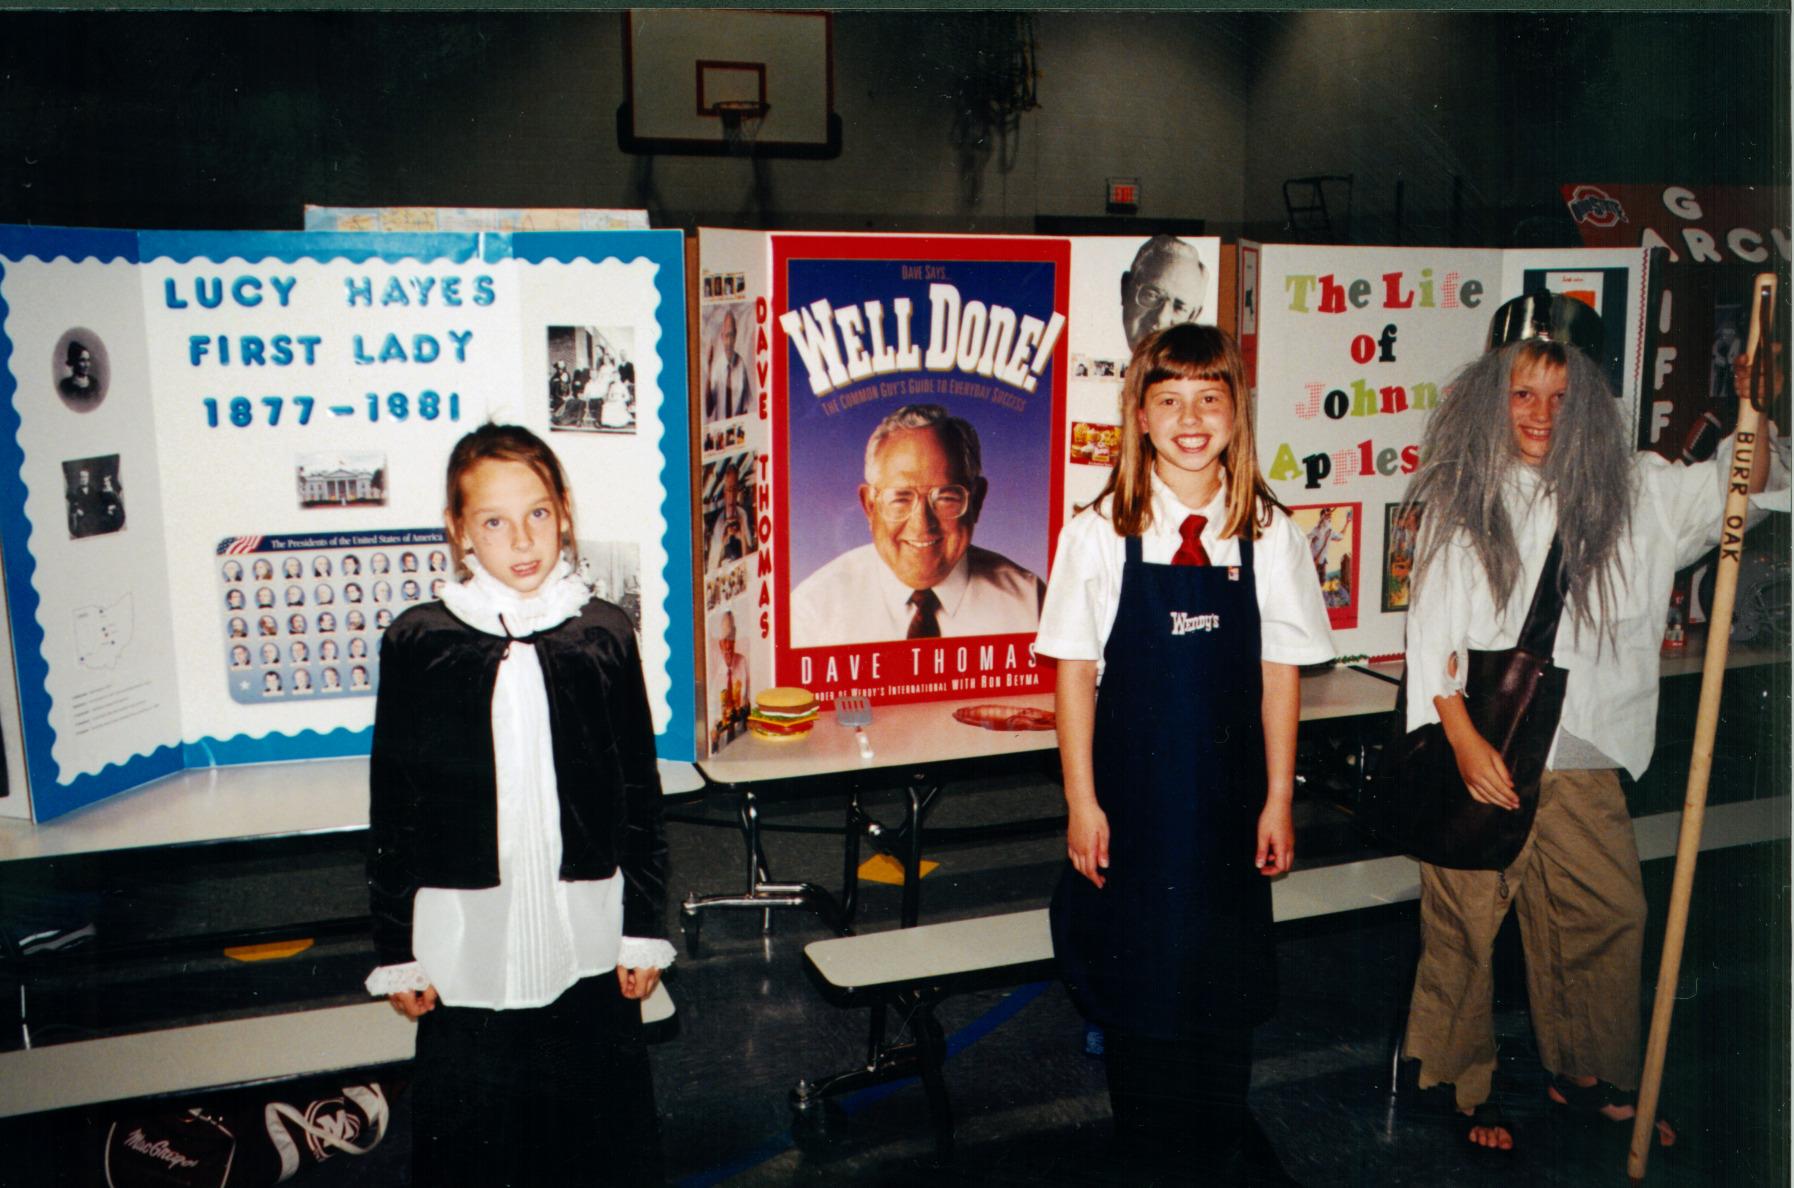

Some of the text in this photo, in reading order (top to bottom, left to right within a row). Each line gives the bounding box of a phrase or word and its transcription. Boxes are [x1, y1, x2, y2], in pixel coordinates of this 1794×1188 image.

[164, 275, 496, 310] LUCY HAYES
[902, 265, 923, 281] DAVE
[1285, 268, 1484, 314] The Life
[188, 329, 473, 367] FIRST LADY
[779, 297, 923, 397] WELL
[1350, 323, 1398, 364] of
[821, 378, 1027, 416] THE COMMON GUY'S GUIDE TO EVERYDAY SUCCESS
[1295, 378, 1455, 420] Johnn
[756, 296, 772, 639] DAVE THOMAS
[1269, 439, 1424, 489] Apples
[1721, 432, 1755, 563] BURR OAK
[271, 532, 443, 549] The Presidents of the United States of America
[801, 642, 1037, 684] DAVE THOMAS
[815, 691, 834, 702] NDER
[888, 683, 947, 696] INTERNATIONAL
[952, 678, 976, 691] WITH
[981, 674, 1001, 688] RON
